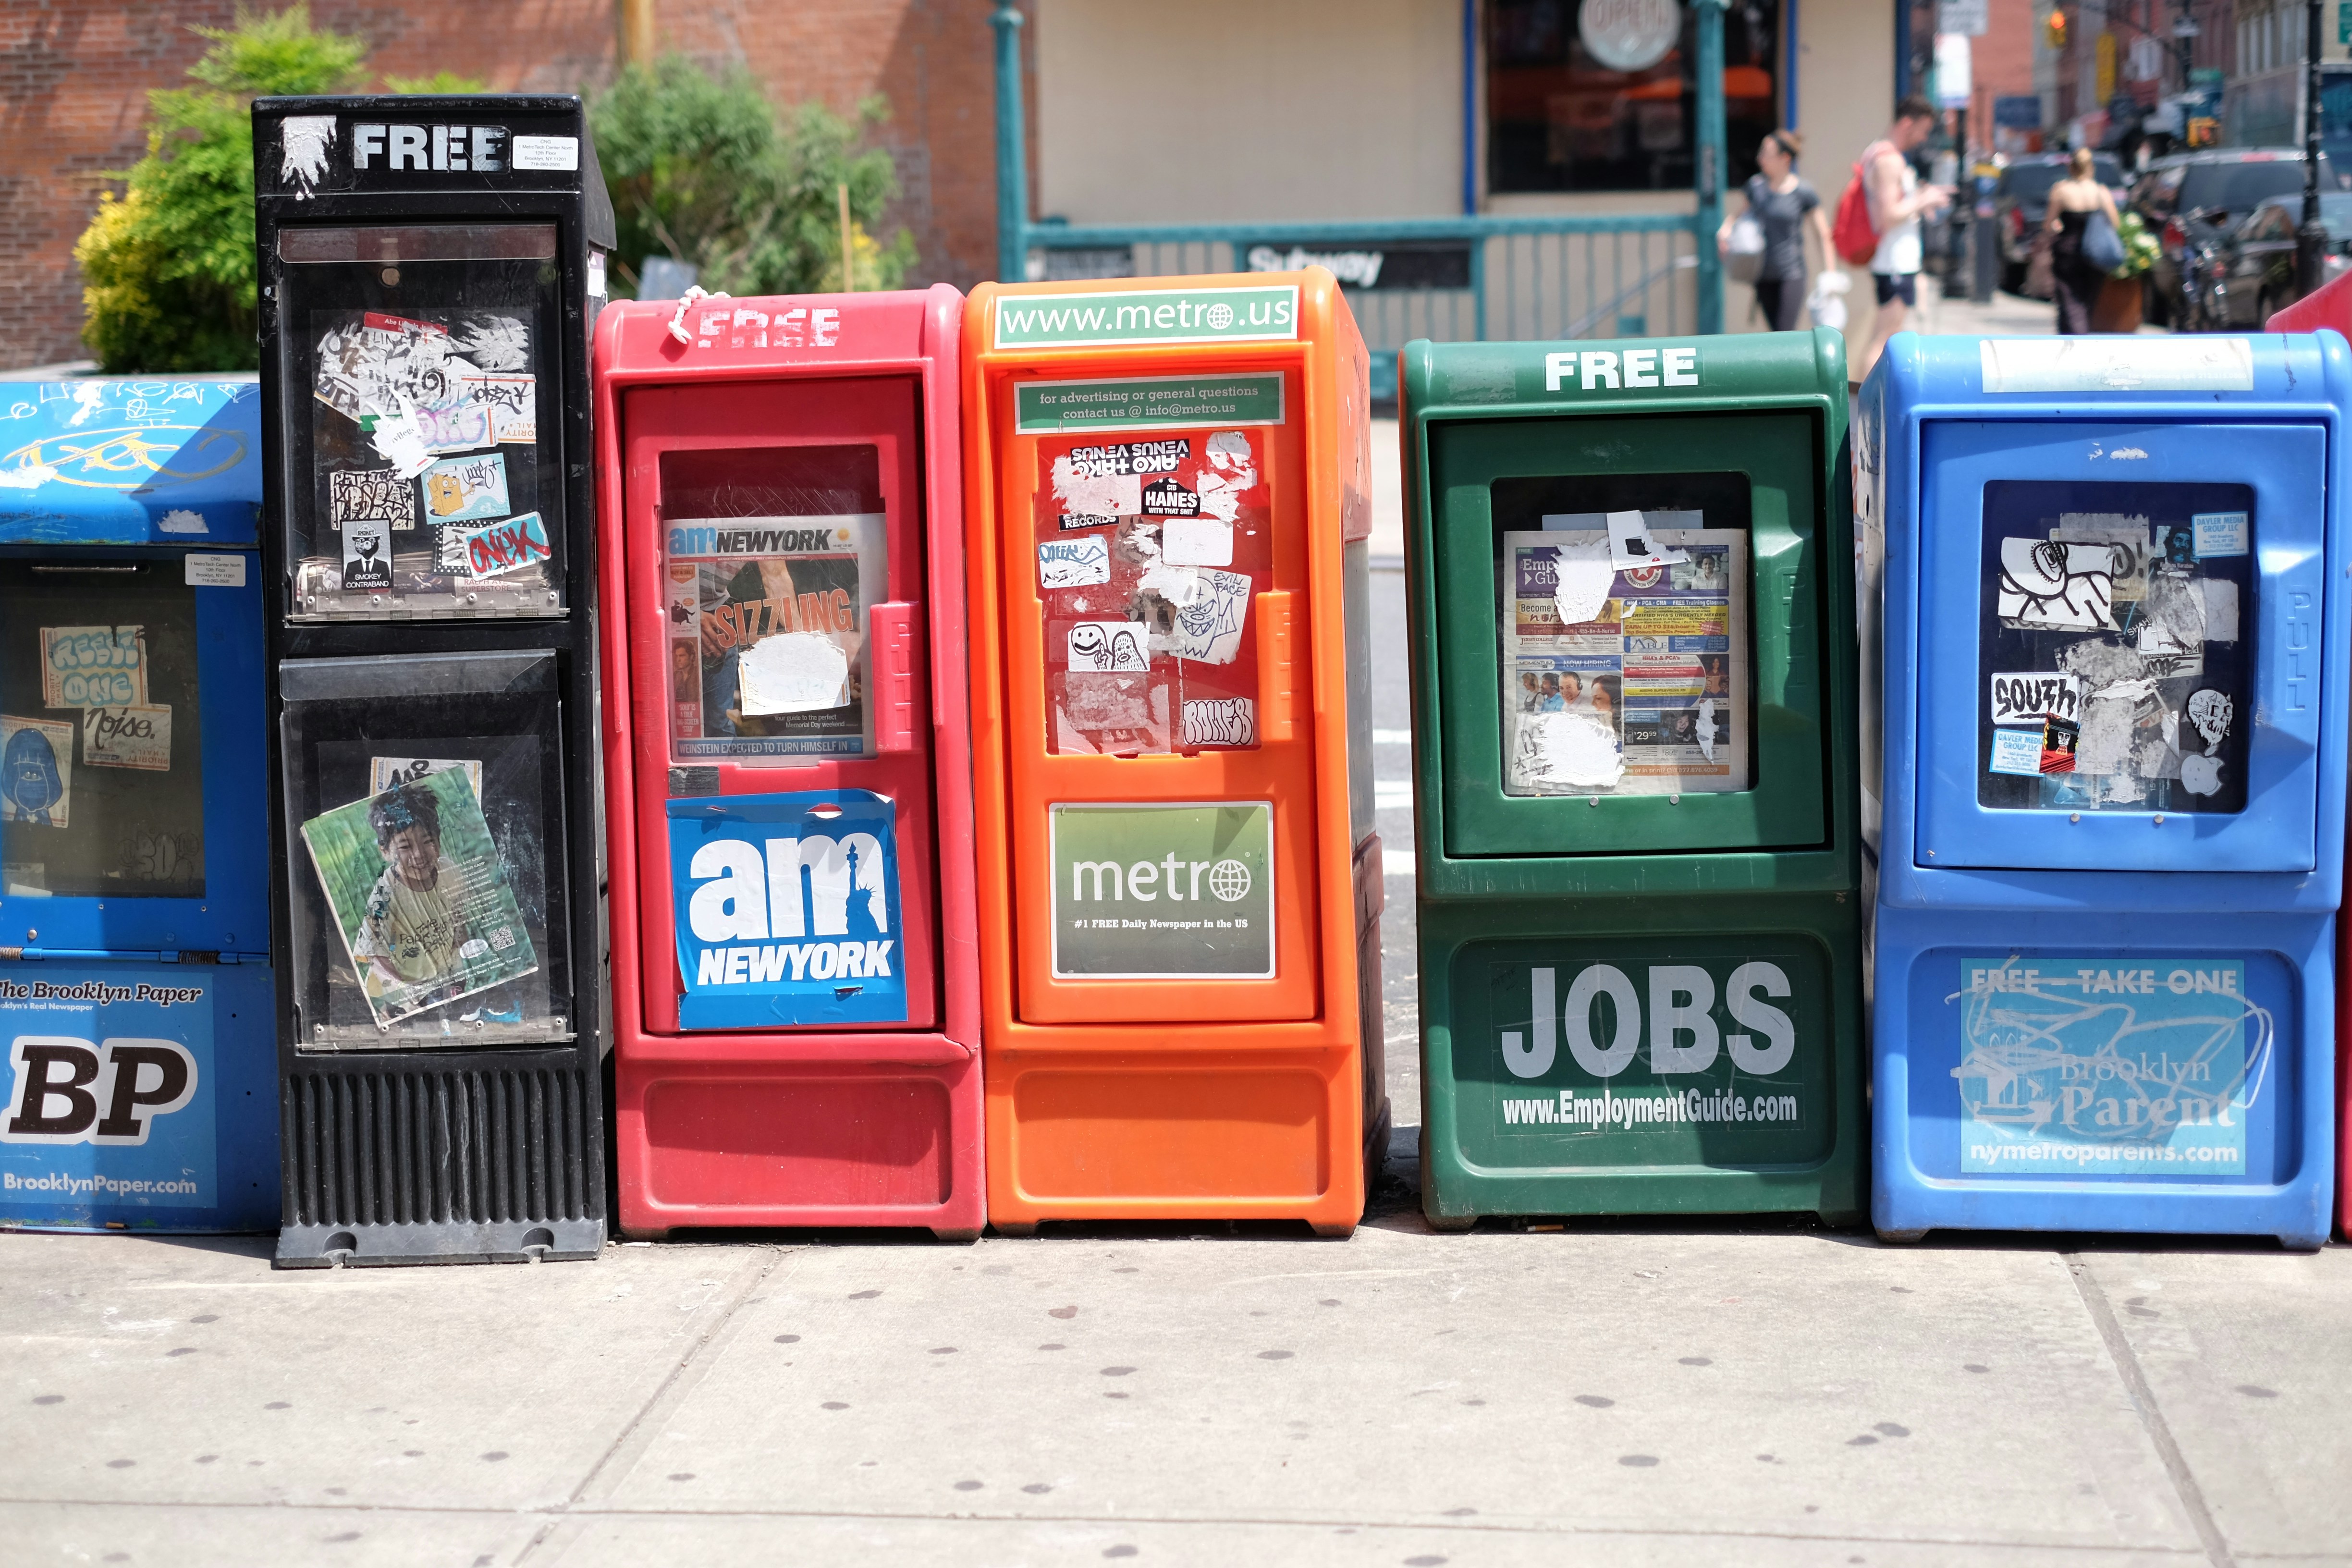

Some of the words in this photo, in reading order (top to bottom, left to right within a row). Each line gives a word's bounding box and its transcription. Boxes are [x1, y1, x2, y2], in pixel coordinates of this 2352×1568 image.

[354, 124, 506, 172] FREE
[698, 307, 841, 348] FREE
[1545, 347, 1699, 392] FREE
[1040, 393, 1056, 404] for
[1060, 391, 1128, 405] advertising
[1132, 392, 1145, 401] or
[1148, 387, 1195, 402] general
[1198, 385, 1258, 399] questions
[1063, 408, 1107, 419] contact
[1110, 407, 1125, 417] us
[1128, 405, 1142, 418] @
[1145, 403, 1236, 416] info@metro.us
[1131, 440, 1189, 456] VENUS
[1145, 491, 1197, 508] HANES
[1065, 515, 1116, 528] RECORDS
[2196, 517, 2221, 526] DAVLER
[669, 527, 716, 554] am
[716, 529, 833, 553] NEWYORK
[346, 580, 389, 588] CONTRABAND
[1215, 582, 1247, 597] FACE
[714, 588, 854, 649] SIZZLING
[1521, 604, 1551, 612] Become
[1631, 638, 1668, 649] ABLE
[2286, 592, 2311, 710] PULL
[891, 622, 915, 734] PULL
[818, 713, 837, 722] perfect
[679, 743, 720, 754] WEINSTEIN
[721, 743, 762, 753] EXPECTED
[763, 743, 775, 753] TO
[777, 742, 799, 752] TURN
[801, 741, 837, 752] HIMSELF
[838, 741, 847, 751] IN
[1998, 734, 2022, 743] DAVLER
[2003, 742, 2026, 750] GROUP
[127, 755, 168, 765] PRIORITY
[690, 833, 888, 943] am
[1073, 851, 1251, 902] metro
[1074, 919, 1088, 928] #1
[1092, 919, 1119, 928] FREE
[1122, 919, 1147, 930] Daily
[1150, 919, 1201, 930] Newspaper
[1204, 919, 1214, 928] in
[1216, 919, 1232, 928] the
[1235, 919, 1248, 928] US
[697, 940, 894, 986] NEWYORK
[1971, 968, 2039, 993] FREE
[2077, 969, 2155, 994] TAKE
[2167, 969, 2237, 994] ONE
[33, 982, 132, 1004] Brooklyn
[136, 984, 202, 1005] Paper
[49, 1003, 94, 1012] Newspaper
[1501, 961, 1795, 1078] JOBS
[2059, 1052, 2211, 1092] Brooklyn
[8, 1044, 188, 1137] BP
[1502, 1087, 1797, 1129] www.EmploymentGuide.com
[2059, 1085, 2236, 1127] Parent
[1970, 1143, 2238, 1166] nymetroparents.com
[4, 1173, 197, 1196] BrooklynPaper.com
